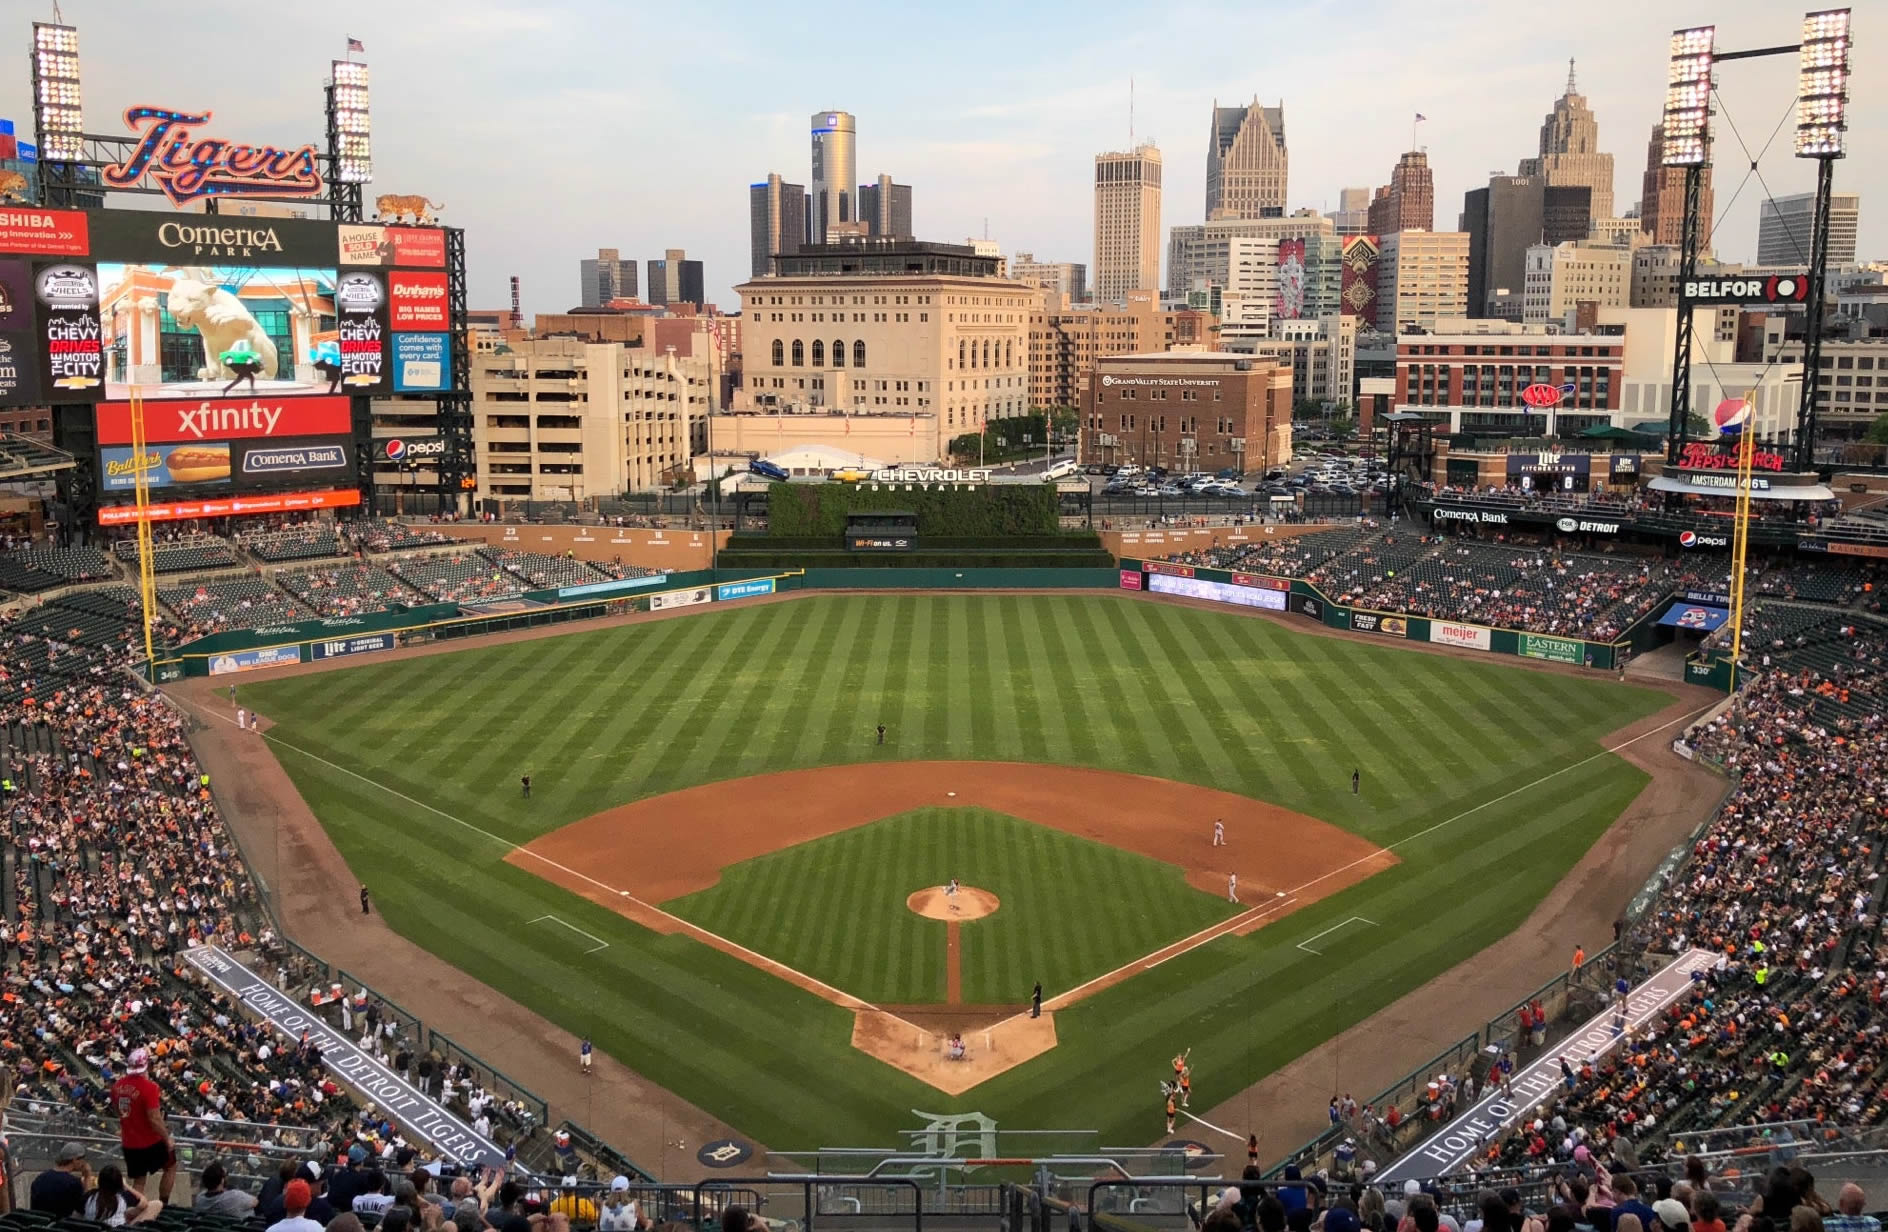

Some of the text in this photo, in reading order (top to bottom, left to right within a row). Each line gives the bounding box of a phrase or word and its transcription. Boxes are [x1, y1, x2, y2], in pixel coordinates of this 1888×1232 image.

[102, 105, 322, 208] Tigers
[9, 230, 57, 239] Innovation
[349, 232, 377, 242] HOUSE
[195, 246, 251, 257] PARK
[349, 243, 373, 252] SOLD
[350, 252, 375, 260] NAME
[51, 287, 89, 295] WHEELS
[393, 284, 444, 296] Dunham's
[1685, 281, 1761, 298] BELFOR
[415, 313, 443, 321] PRICES
[48, 327, 98, 340] CHEVY
[340, 328, 381, 341] CHEVY
[398, 335, 442, 344] Confidence
[49, 340, 100, 353] DRIVES
[341, 340, 382, 352] DRIVES
[426, 343, 443, 352] with
[63, 353, 100, 362] MOTOR
[352, 352, 382, 361] MOTOR
[399, 353, 421, 361] every
[50, 353, 63, 376] THE
[64, 362, 100, 376] CITY
[342, 353, 352, 374] THE
[352, 361, 382, 373] CITY
[1111, 377, 1220, 387] GRAND VALLEY STATE UNIVERSITY
[178, 402, 282, 438] xfinity
[408, 440, 445, 456] pepsi
[308, 450, 338, 462] Bank
[1538, 452, 1561, 466] Lite
[877, 469, 992, 482] CHEVROLET
[1691, 474, 1737, 488] AMSTERDAM
[855, 484, 975, 492] FOUNTAIN
[1481, 511, 1508, 524] Bank
[1235, 527, 1241, 535] 11
[1580, 521, 1619, 533] DETROIT
[1697, 536, 1727, 547] pepsi
[747, 585, 770, 593] Energy
[1688, 592, 1732, 604] BELLE TIR
[1355, 614, 1377, 622] FRESH
[1356, 622, 1374, 630] FAST
[1442, 625, 1478, 640] meijer
[324, 642, 346, 656] Lite
[351, 642, 384, 653] LIGHT BEER
[1527, 636, 1577, 653] EASTERN
[259, 649, 278, 658] DMC
[240, 983, 487, 1161] HOME OF THE DETROIT TIGERS
[1424, 986, 1669, 1164] HOME OF THE DETROIT TIGERS
